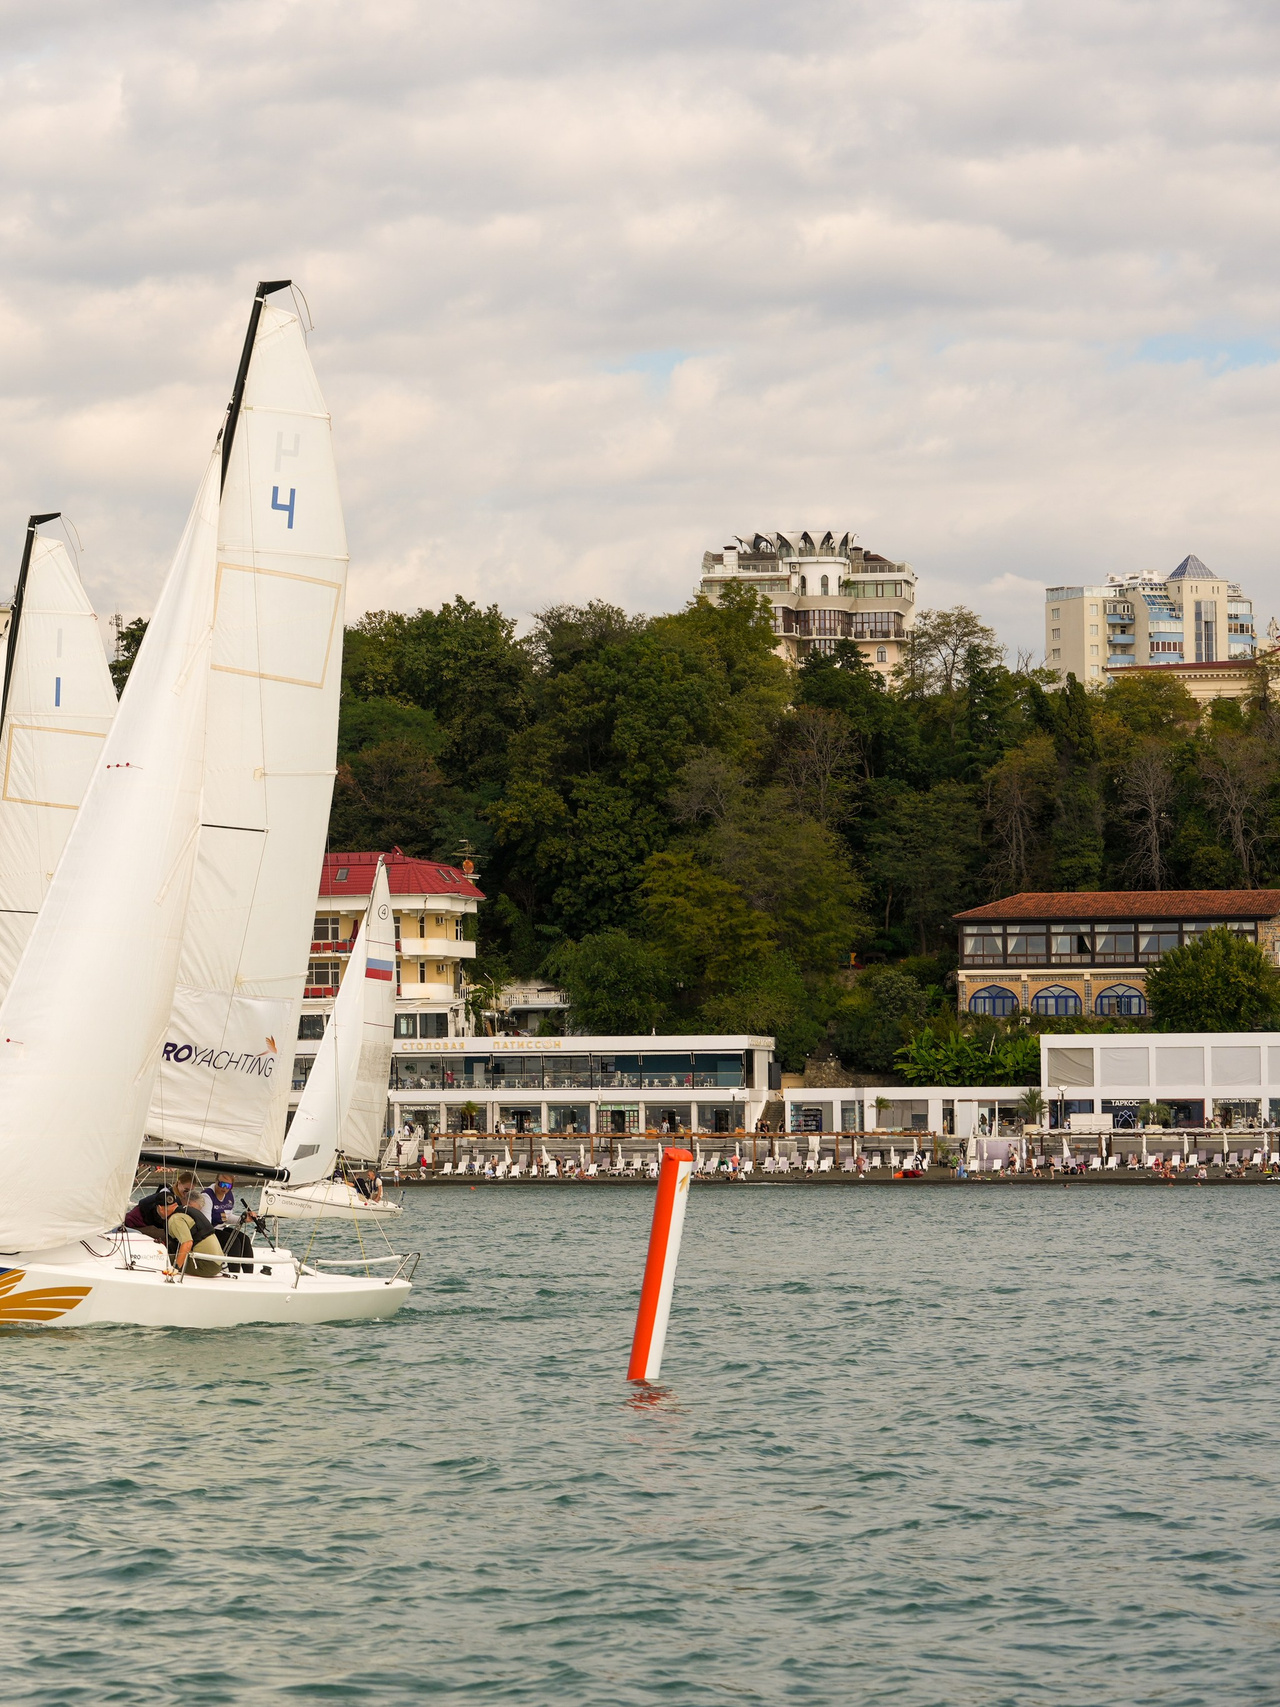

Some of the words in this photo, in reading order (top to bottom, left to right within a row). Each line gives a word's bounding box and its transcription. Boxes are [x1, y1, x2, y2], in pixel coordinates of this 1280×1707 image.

[271, 486, 296, 529] 4
[401, 1041, 466, 1051] СТОЛОВАЯ
[492, 1039, 562, 1050] ПАТИССОН
[161, 1041, 275, 1078] ROYACHTING
[1111, 1099, 1140, 1107] ТАРКОС
